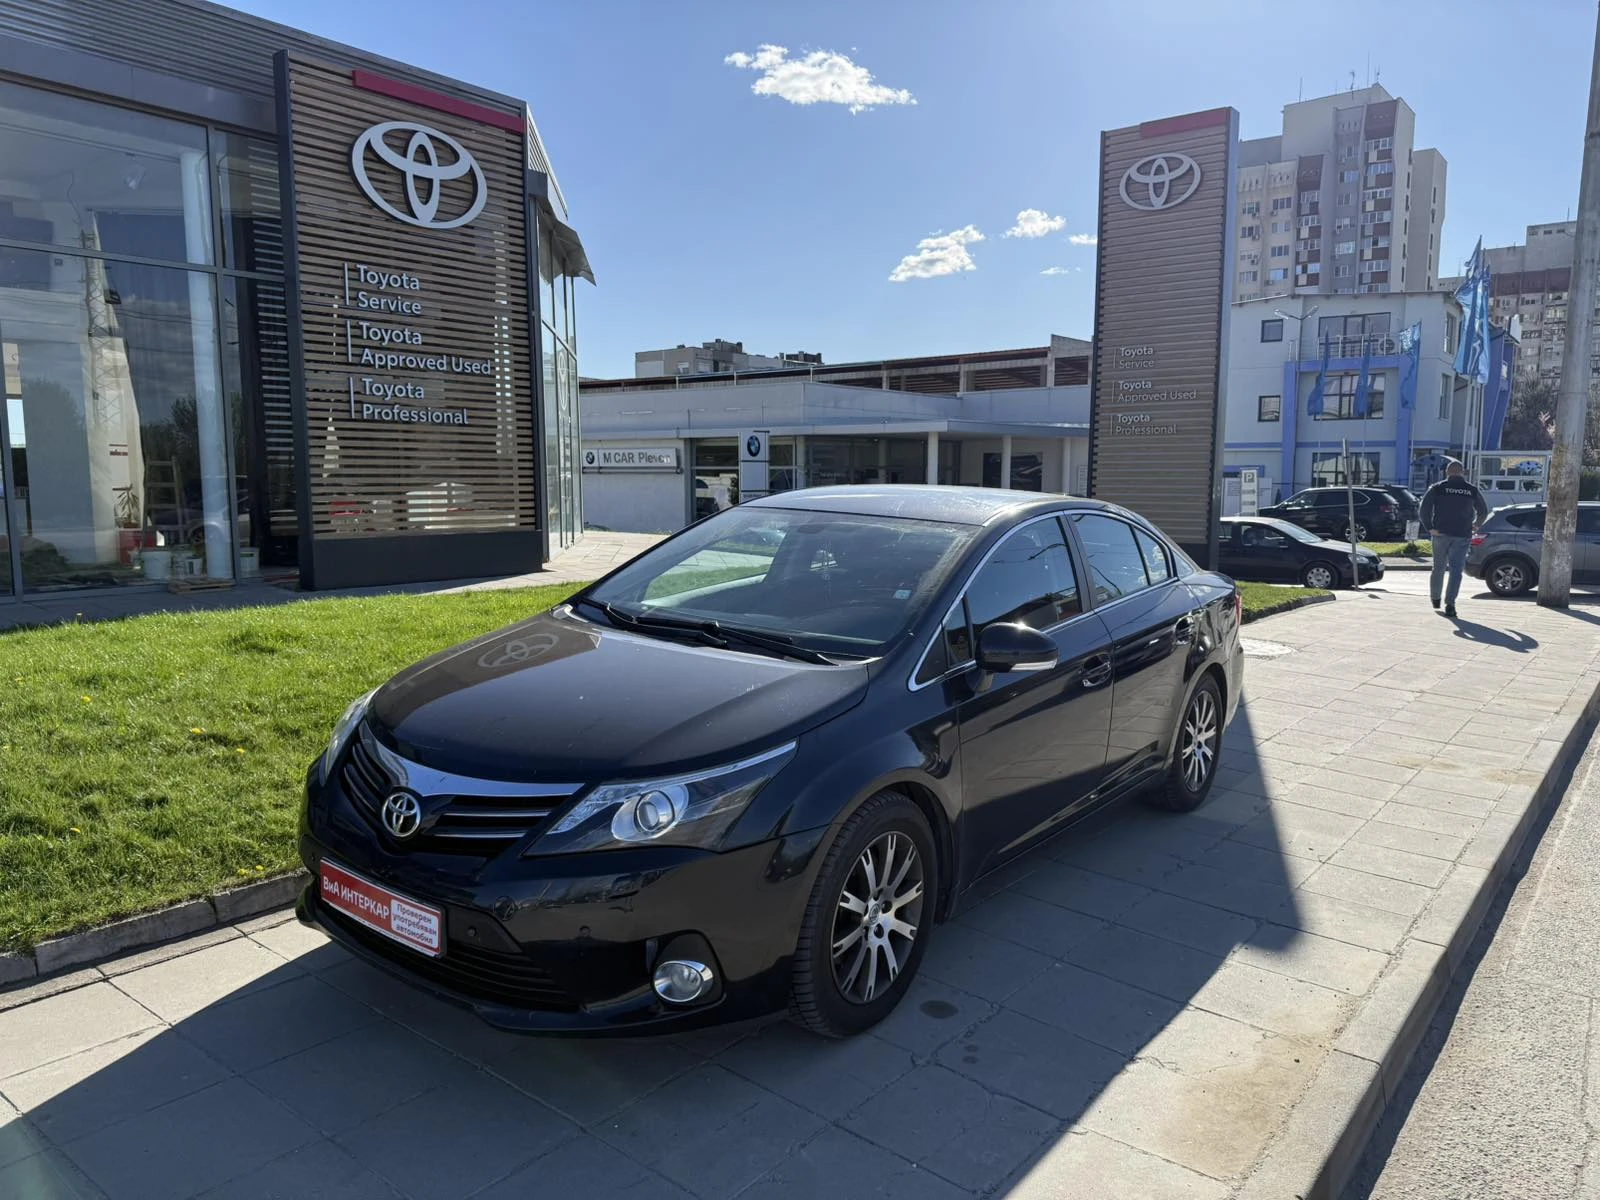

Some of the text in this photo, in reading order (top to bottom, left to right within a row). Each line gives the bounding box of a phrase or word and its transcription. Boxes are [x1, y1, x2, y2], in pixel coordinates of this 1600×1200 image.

[356, 264, 420, 290] Toyota
[358, 291, 422, 314] Service
[359, 321, 422, 346] Toyota
[1120, 347, 1153, 358] Toyota
[361, 348, 491, 375] Approved Used
[1119, 360, 1154, 369] Service
[361, 378, 424, 401] Toyota
[1118, 380, 1152, 392] Toyota
[1118, 389, 1197, 402] Approved Used
[363, 403, 469, 425] Professional
[1116, 413, 1150, 425] Toyota
[1116, 424, 1177, 435] Professional
[603, 451, 671, 463] M CAR Pleven
[1445, 488, 1472, 496] TOYOTA
[323, 875, 390, 920] ВиА ИНТЕРКАР
[397, 903, 432, 925] Проверен
